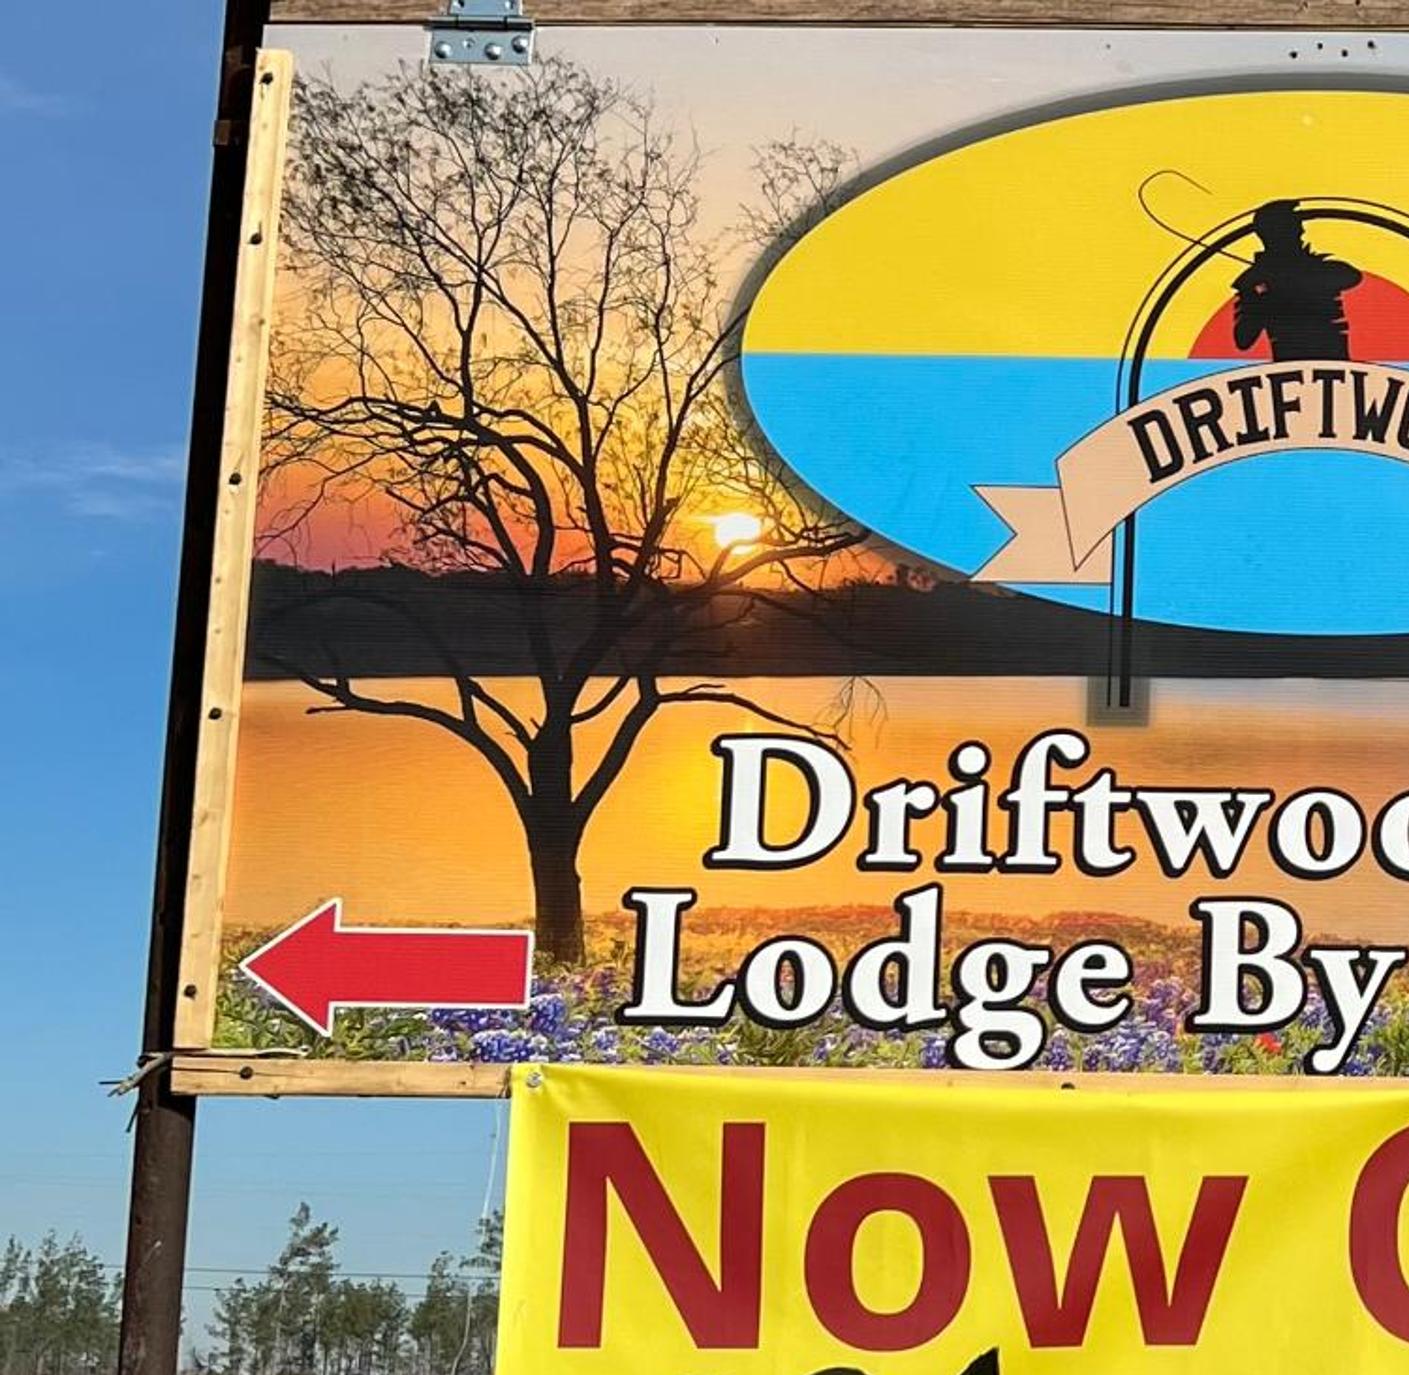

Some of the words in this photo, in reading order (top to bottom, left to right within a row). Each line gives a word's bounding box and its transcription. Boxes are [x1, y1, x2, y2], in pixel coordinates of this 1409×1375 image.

[616, 883, 1133, 1071] Lodge
[1185, 896, 1405, 1075] By
[557, 1120, 1249, 1352] Now
